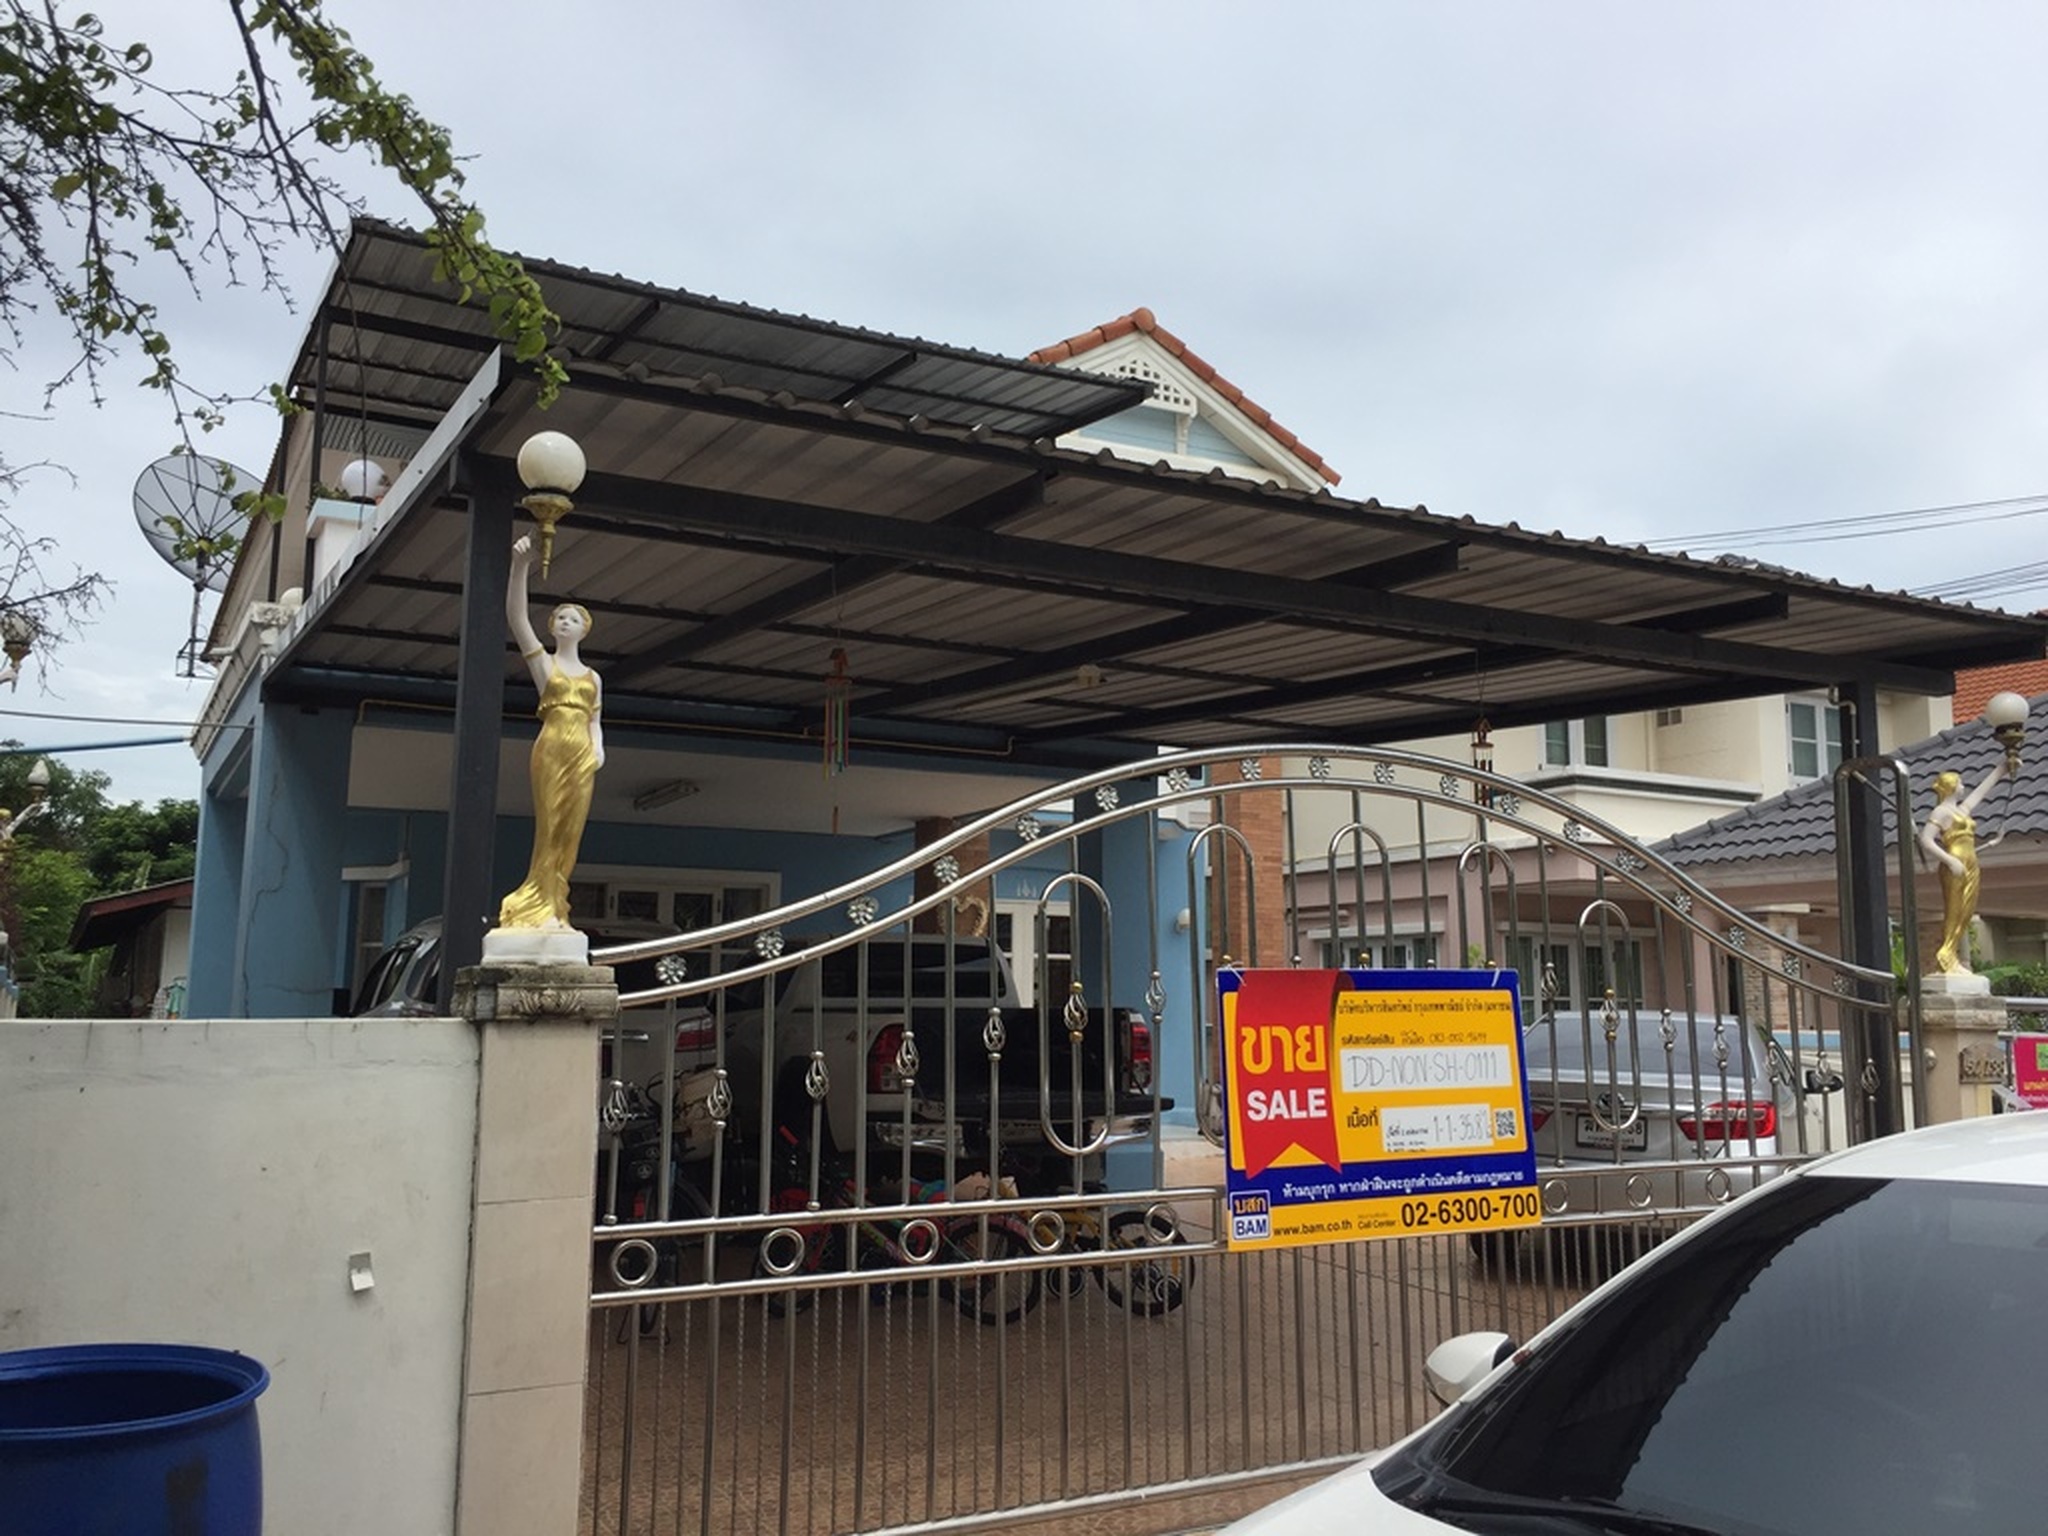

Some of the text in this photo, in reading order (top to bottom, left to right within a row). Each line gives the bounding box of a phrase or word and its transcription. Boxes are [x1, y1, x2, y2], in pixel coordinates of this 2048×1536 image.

[1241, 1025, 1326, 1074] ขาย
[1247, 1088, 1328, 1121] SALE
[1347, 1105, 1379, 1128] เนื้อที่
[1282, 1183, 1335, 1201] ห้ามบุกรุก
[1234, 1197, 1267, 1214] บสก
[1402, 1193, 1537, 1227] 02-6300-700
[1236, 1218, 1267, 1236] BAM
[1274, 1219, 1352, 1236] www.bam.co.th
[1357, 1220, 1371, 1230] Call
